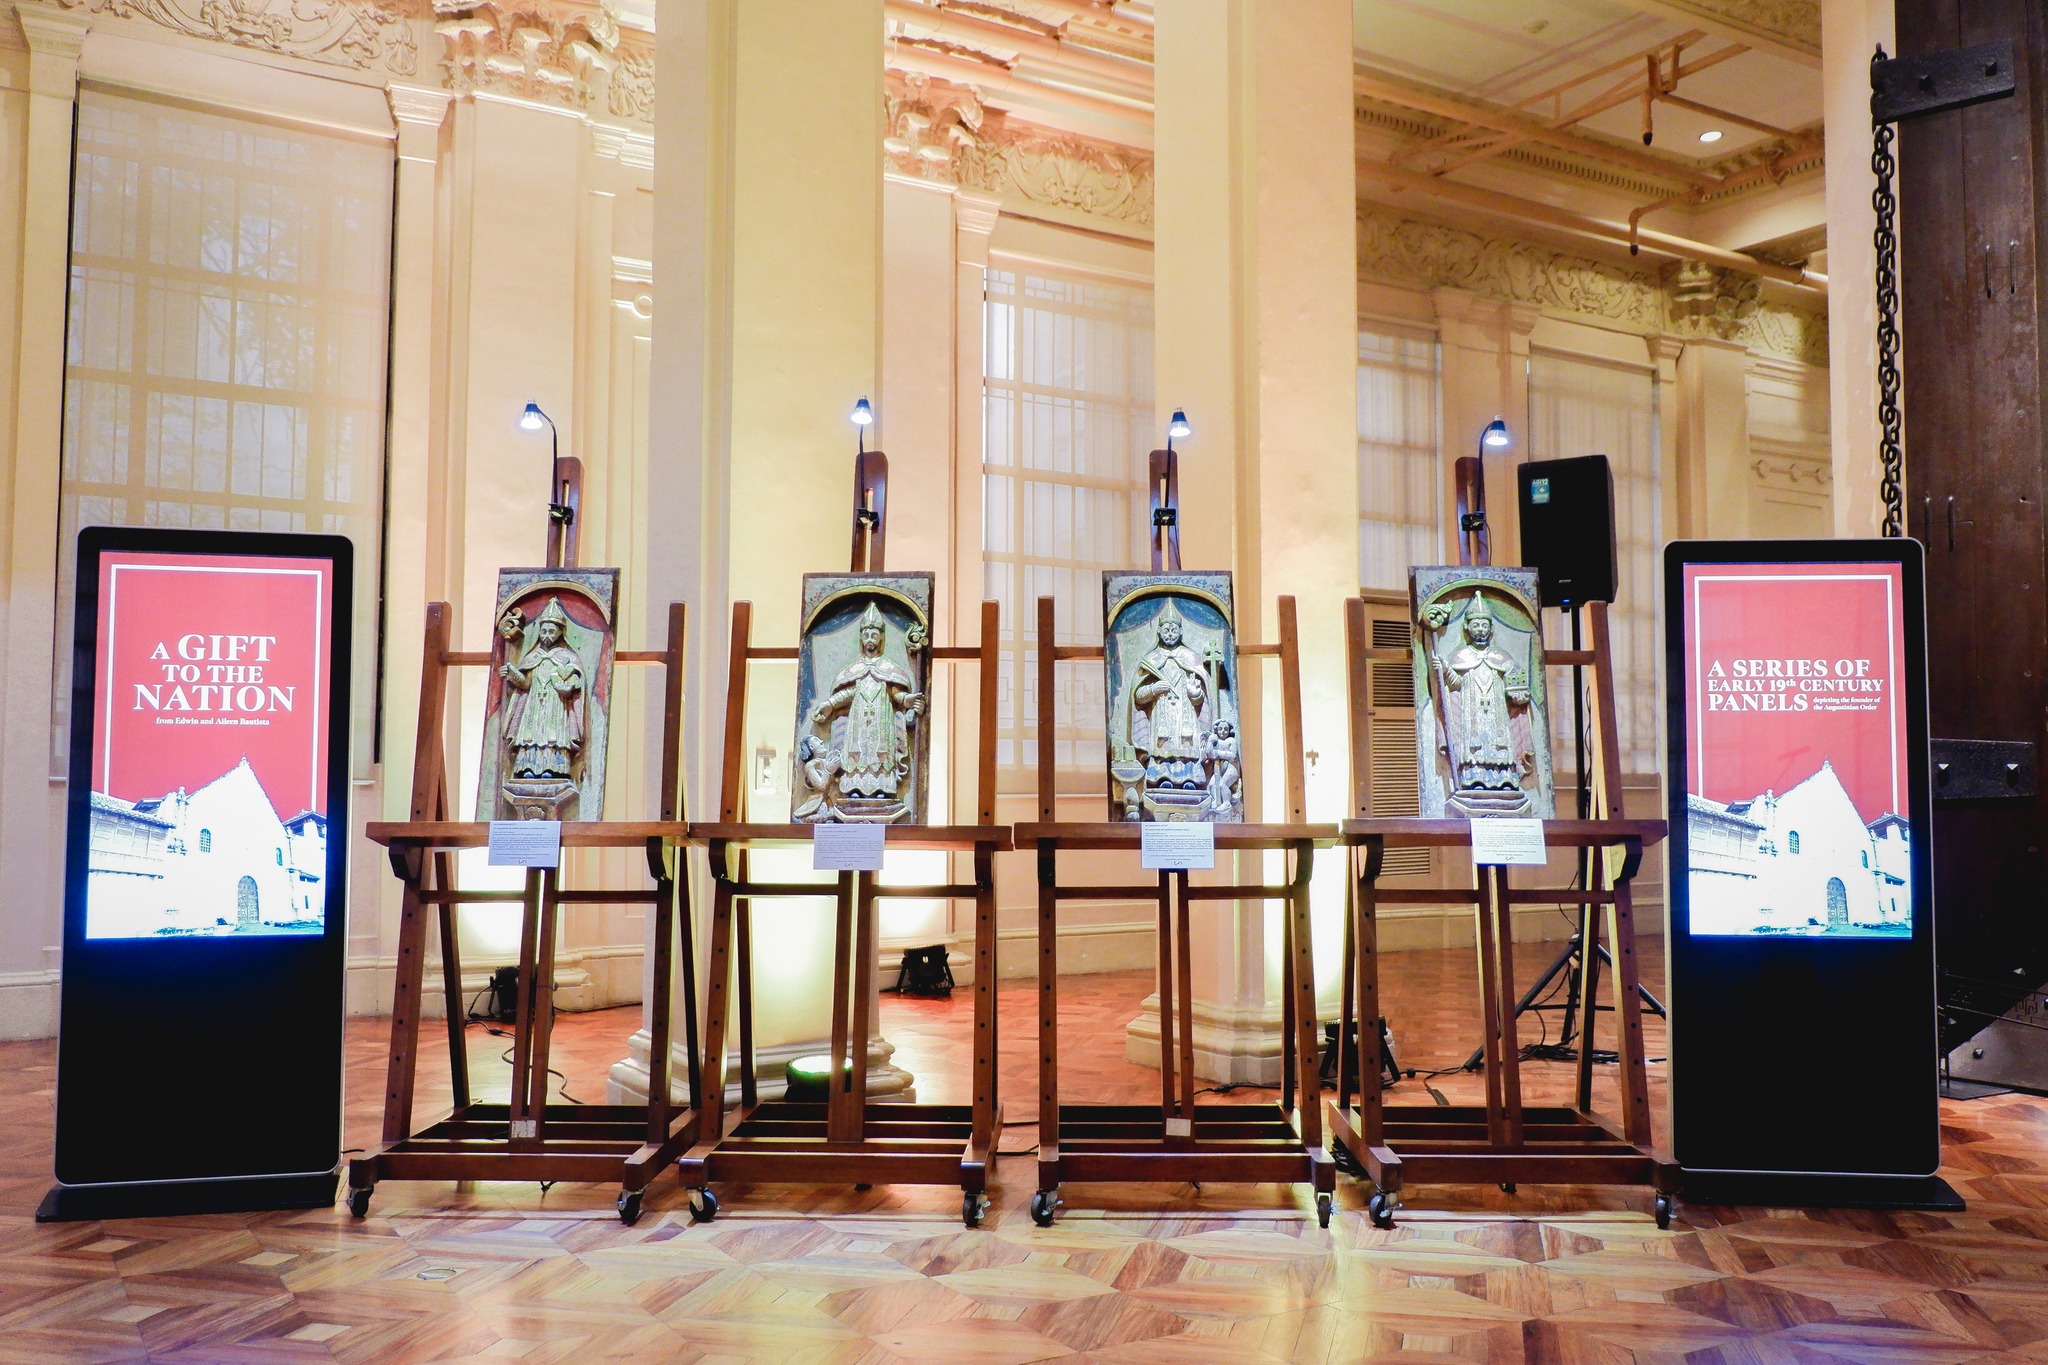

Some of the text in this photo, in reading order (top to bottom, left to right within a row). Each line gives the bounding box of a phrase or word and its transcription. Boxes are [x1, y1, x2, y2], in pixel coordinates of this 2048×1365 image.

[150, 634, 276, 662] A GIFT
[161, 664, 264, 684] TO THE
[1707, 659, 1871, 677] A SERIES OF
[1707, 678, 1884, 692] EARLY 19th CENTURY
[133, 684, 296, 712] NATION
[1707, 693, 1809, 712] PANELS
[1812, 696, 1840, 704] depicting
[1850, 696, 1873, 704] founder
[156, 716, 270, 726] from Edwin and Aileen Bautista
